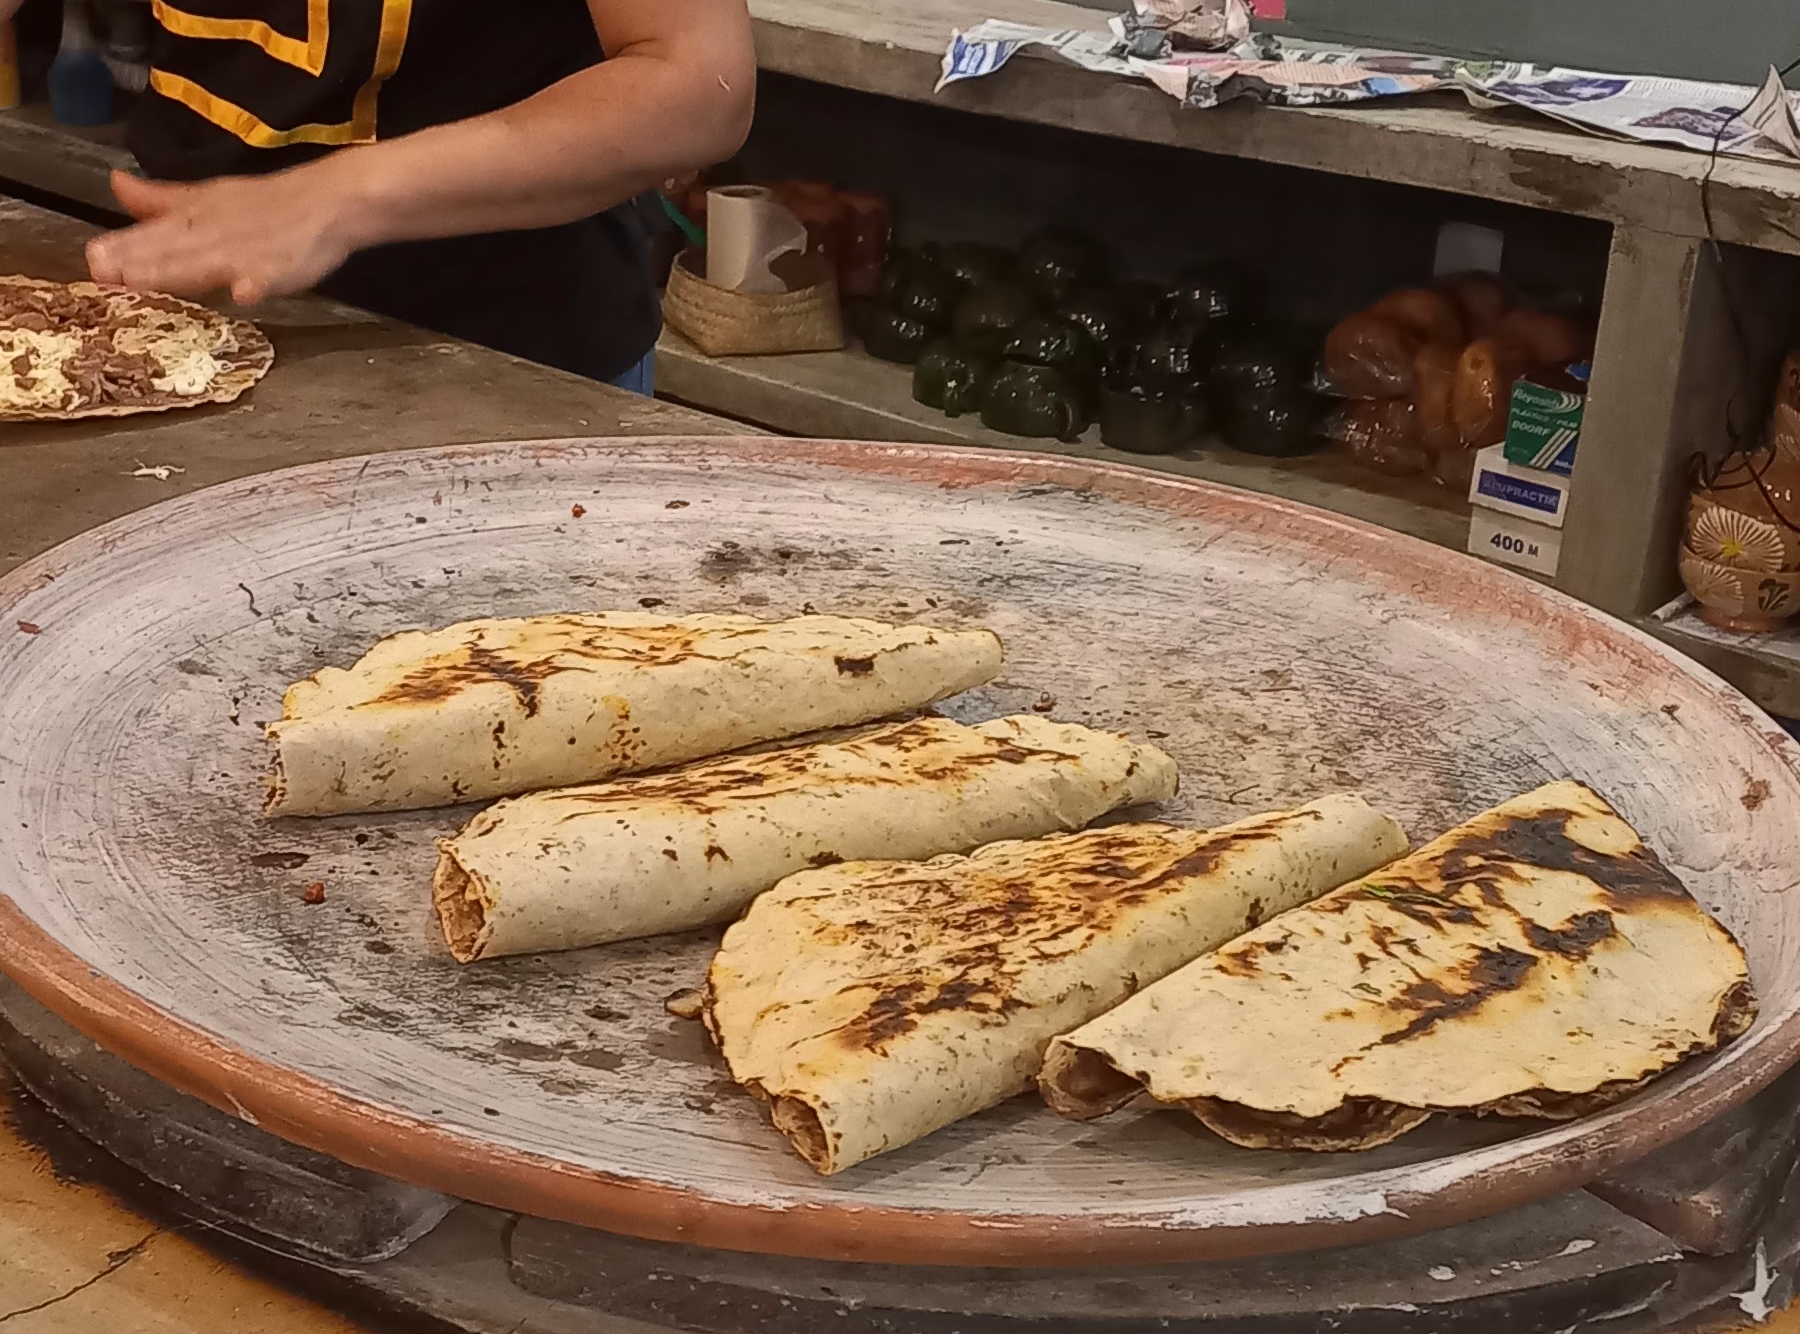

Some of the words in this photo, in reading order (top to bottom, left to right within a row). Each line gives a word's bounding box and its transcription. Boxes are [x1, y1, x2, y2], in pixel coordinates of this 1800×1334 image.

[1513, 388, 1560, 408] Reynolds
[1490, 533, 1524, 553] 400
[1527, 544, 1539, 557] M
